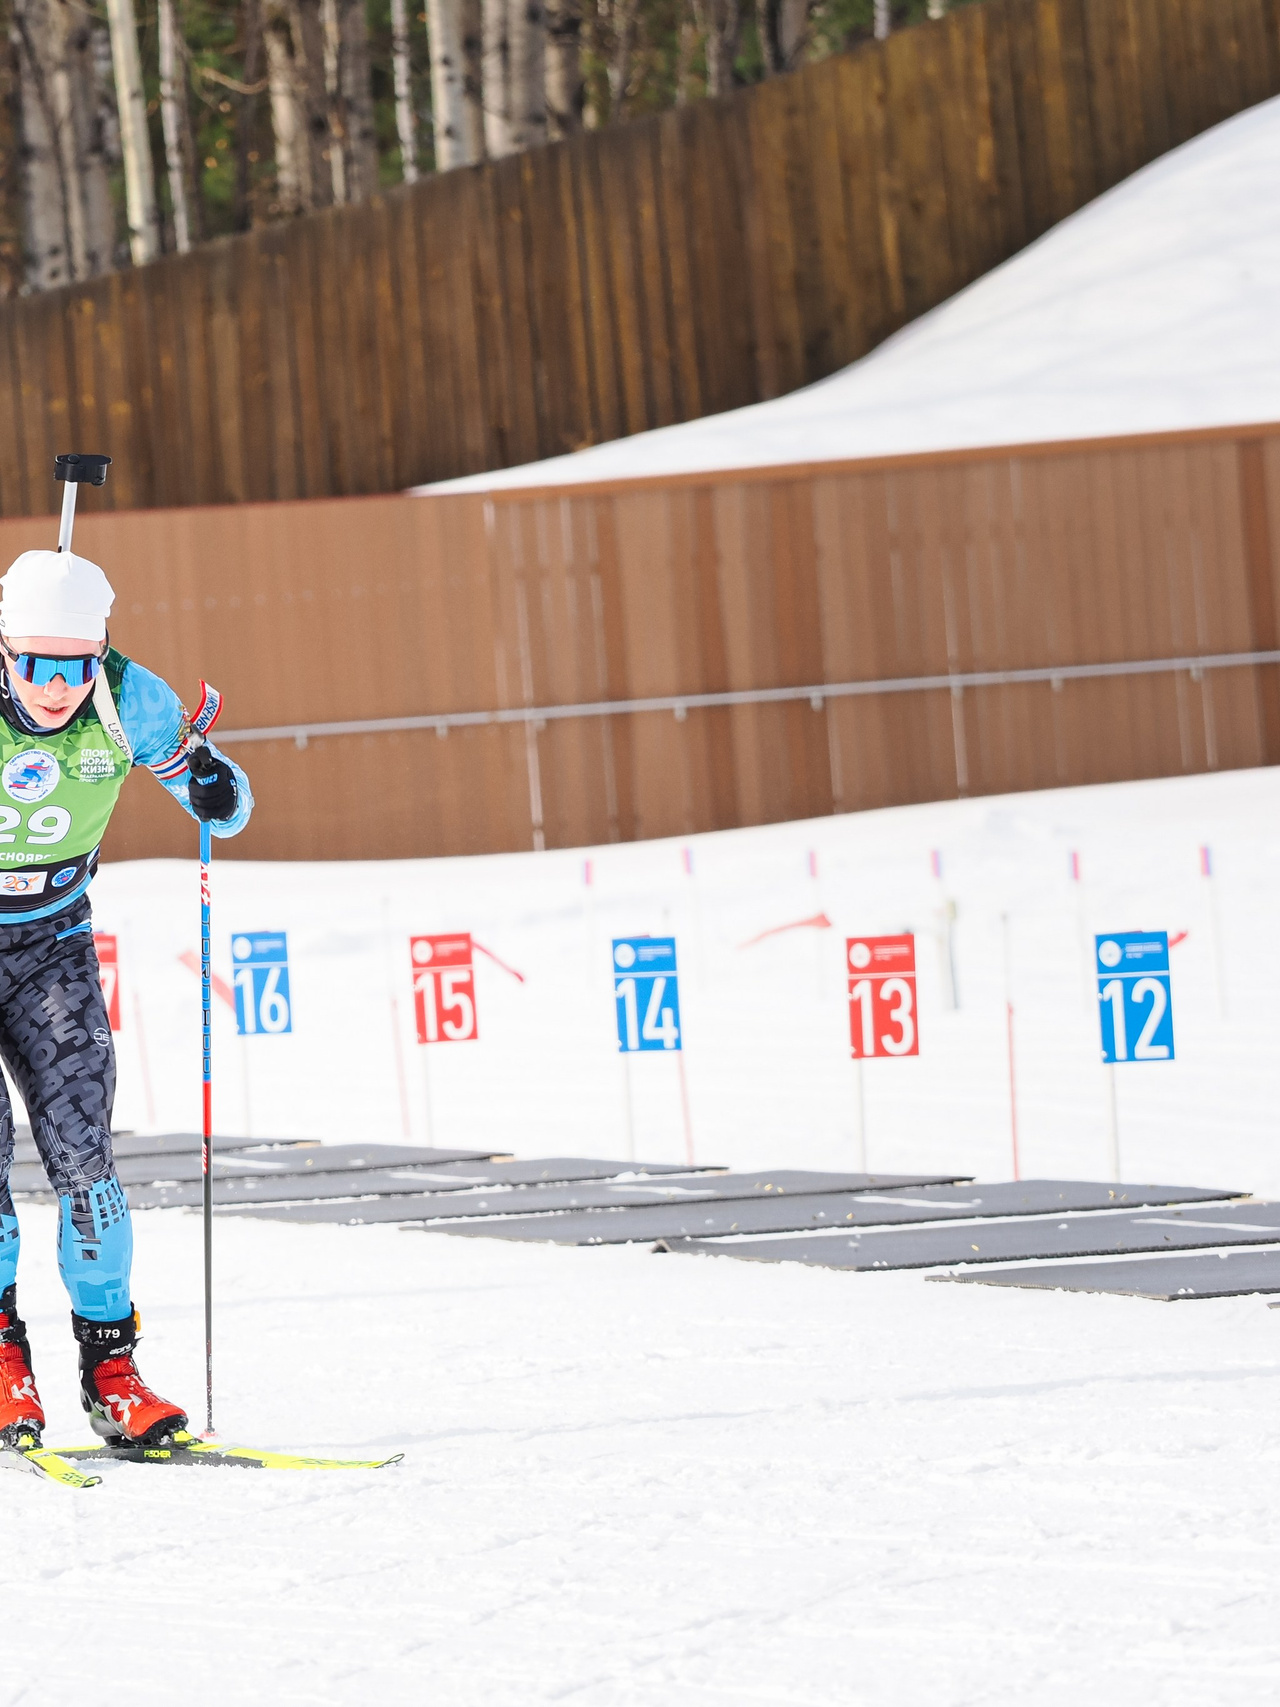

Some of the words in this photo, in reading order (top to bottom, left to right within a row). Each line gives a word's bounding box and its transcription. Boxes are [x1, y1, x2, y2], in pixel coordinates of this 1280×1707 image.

[80, 757, 114, 766] НОРМА
[80, 765, 116, 774] ЖИЗНИ
[100, 966, 118, 1018] 7
[235, 967, 290, 1034] 16
[419, 970, 475, 1042] 15
[619, 976, 679, 1051] 14
[850, 976, 916, 1057] 13
[1100, 977, 1170, 1061] 12
[95, 1328, 121, 1339] 179
[143, 1449, 171, 1459] FISCHER
